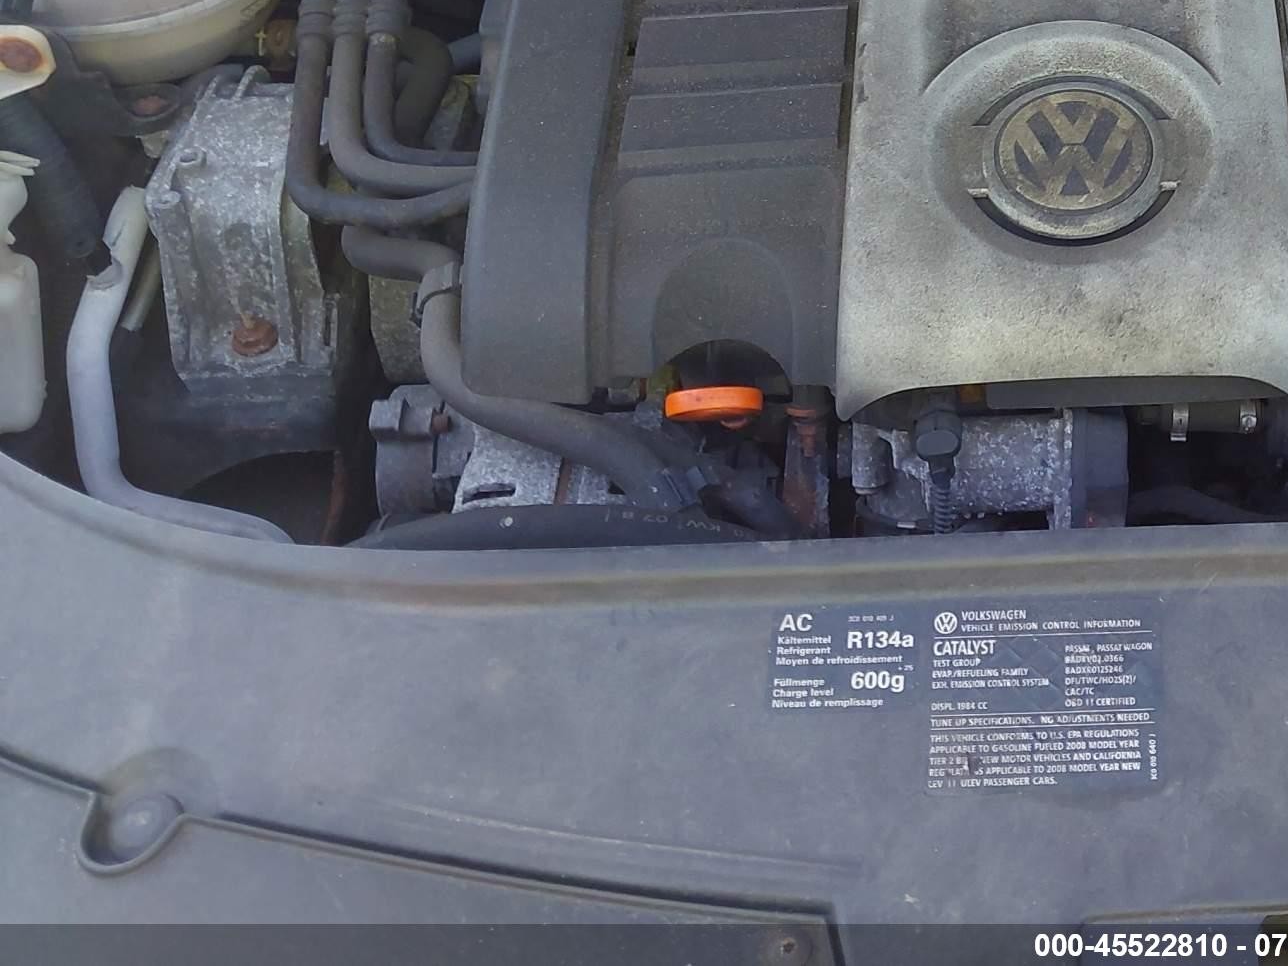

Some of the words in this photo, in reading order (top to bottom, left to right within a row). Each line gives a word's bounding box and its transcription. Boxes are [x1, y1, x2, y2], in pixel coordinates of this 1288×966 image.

[961, 609, 1027, 621] VOLKSWAGEN
[779, 613, 813, 632] AC
[934, 612, 958, 634] VW
[961, 624, 994, 632] VEHICLE
[998, 622, 1038, 631] EMISSION
[1042, 621, 1080, 630] CONTROL
[1083, 619, 1141, 629] INFORMATION
[777, 635, 832, 645] Kältemittel
[847, 631, 914, 649] R134a
[777, 646, 831, 656] Refrigerant
[933, 639, 997, 656] CATALYST
[1096, 643, 1122, 652] PASSAT
[1123, 642, 1152, 651] WAGON
[775, 657, 809, 667] Moyen
[812, 656, 824, 665] de
[826, 655, 903, 665] refroidissement
[933, 659, 950, 667] TEST
[952, 658, 981, 667] GROUP
[1001, 668, 1029, 676] FAMILY
[773, 678, 825, 688] Füllmenge
[851, 670, 905, 692] 600g
[950, 680, 986, 688] EMISSION
[987, 679, 1020, 688] CONTROL
[1021, 678, 1049, 686] SYSTEM
[772, 689, 808, 698] Charge
[810, 688, 834, 697] level
[1064, 687, 1095, 696] CAC/TC
[772, 700, 807, 708] Niveau
[809, 699, 822, 707] de
[824, 698, 884, 708] remplissage
[957, 702, 976, 710] 1984
[977, 701, 988, 710] CC
[1064, 698, 1083, 707] OBD
[1095, 697, 1136, 706] CERTIFIED
[930, 718, 953, 727] TUNE
[955, 718, 967, 727] UP
[1056, 713, 1116, 723] ADJUSTMENTS
[1116, 712, 1150, 722] NEEDED
[930, 734, 950, 743] THIS
[951, 734, 985, 742] VEHICLE
[987, 732, 1034, 742] CONFORMS
[1035, 732, 1048, 740] TO
[1067, 731, 1082, 739] EPA
[1083, 729, 1140, 738] REGULATIONS
[929, 745, 977, 754] APPLICABLE
[978, 744, 990, 753] TO
[991, 743, 1032, 753] GASOLINE
[1034, 743, 1064, 751] FUELED
[1065, 741, 1087, 750] 2008
[1088, 741, 1118, 750] MODEL
[1118, 739, 1140, 748] YEAR
[929, 757, 947, 766] TIER
[949, 757, 954, 765] 2
[1001, 755, 1032, 764] MOTOR
[1033, 753, 1072, 762] VEHICLES
[1073, 752, 1091, 761] AND
[1093, 751, 1142, 760] CALIFORNIA
[985, 765, 1032, 775] APPLICABLE
[1033, 765, 1045, 773] TO
[1046, 765, 1067, 774] 2008
[1069, 763, 1098, 772] MODEL
[1099, 762, 1120, 771] YEAR
[1121, 761, 1142, 770] NEW
[960, 779, 981, 787] ULEV
[983, 777, 1030, 787] PASSENGER
[1032, 776, 1058, 785] CARS.
